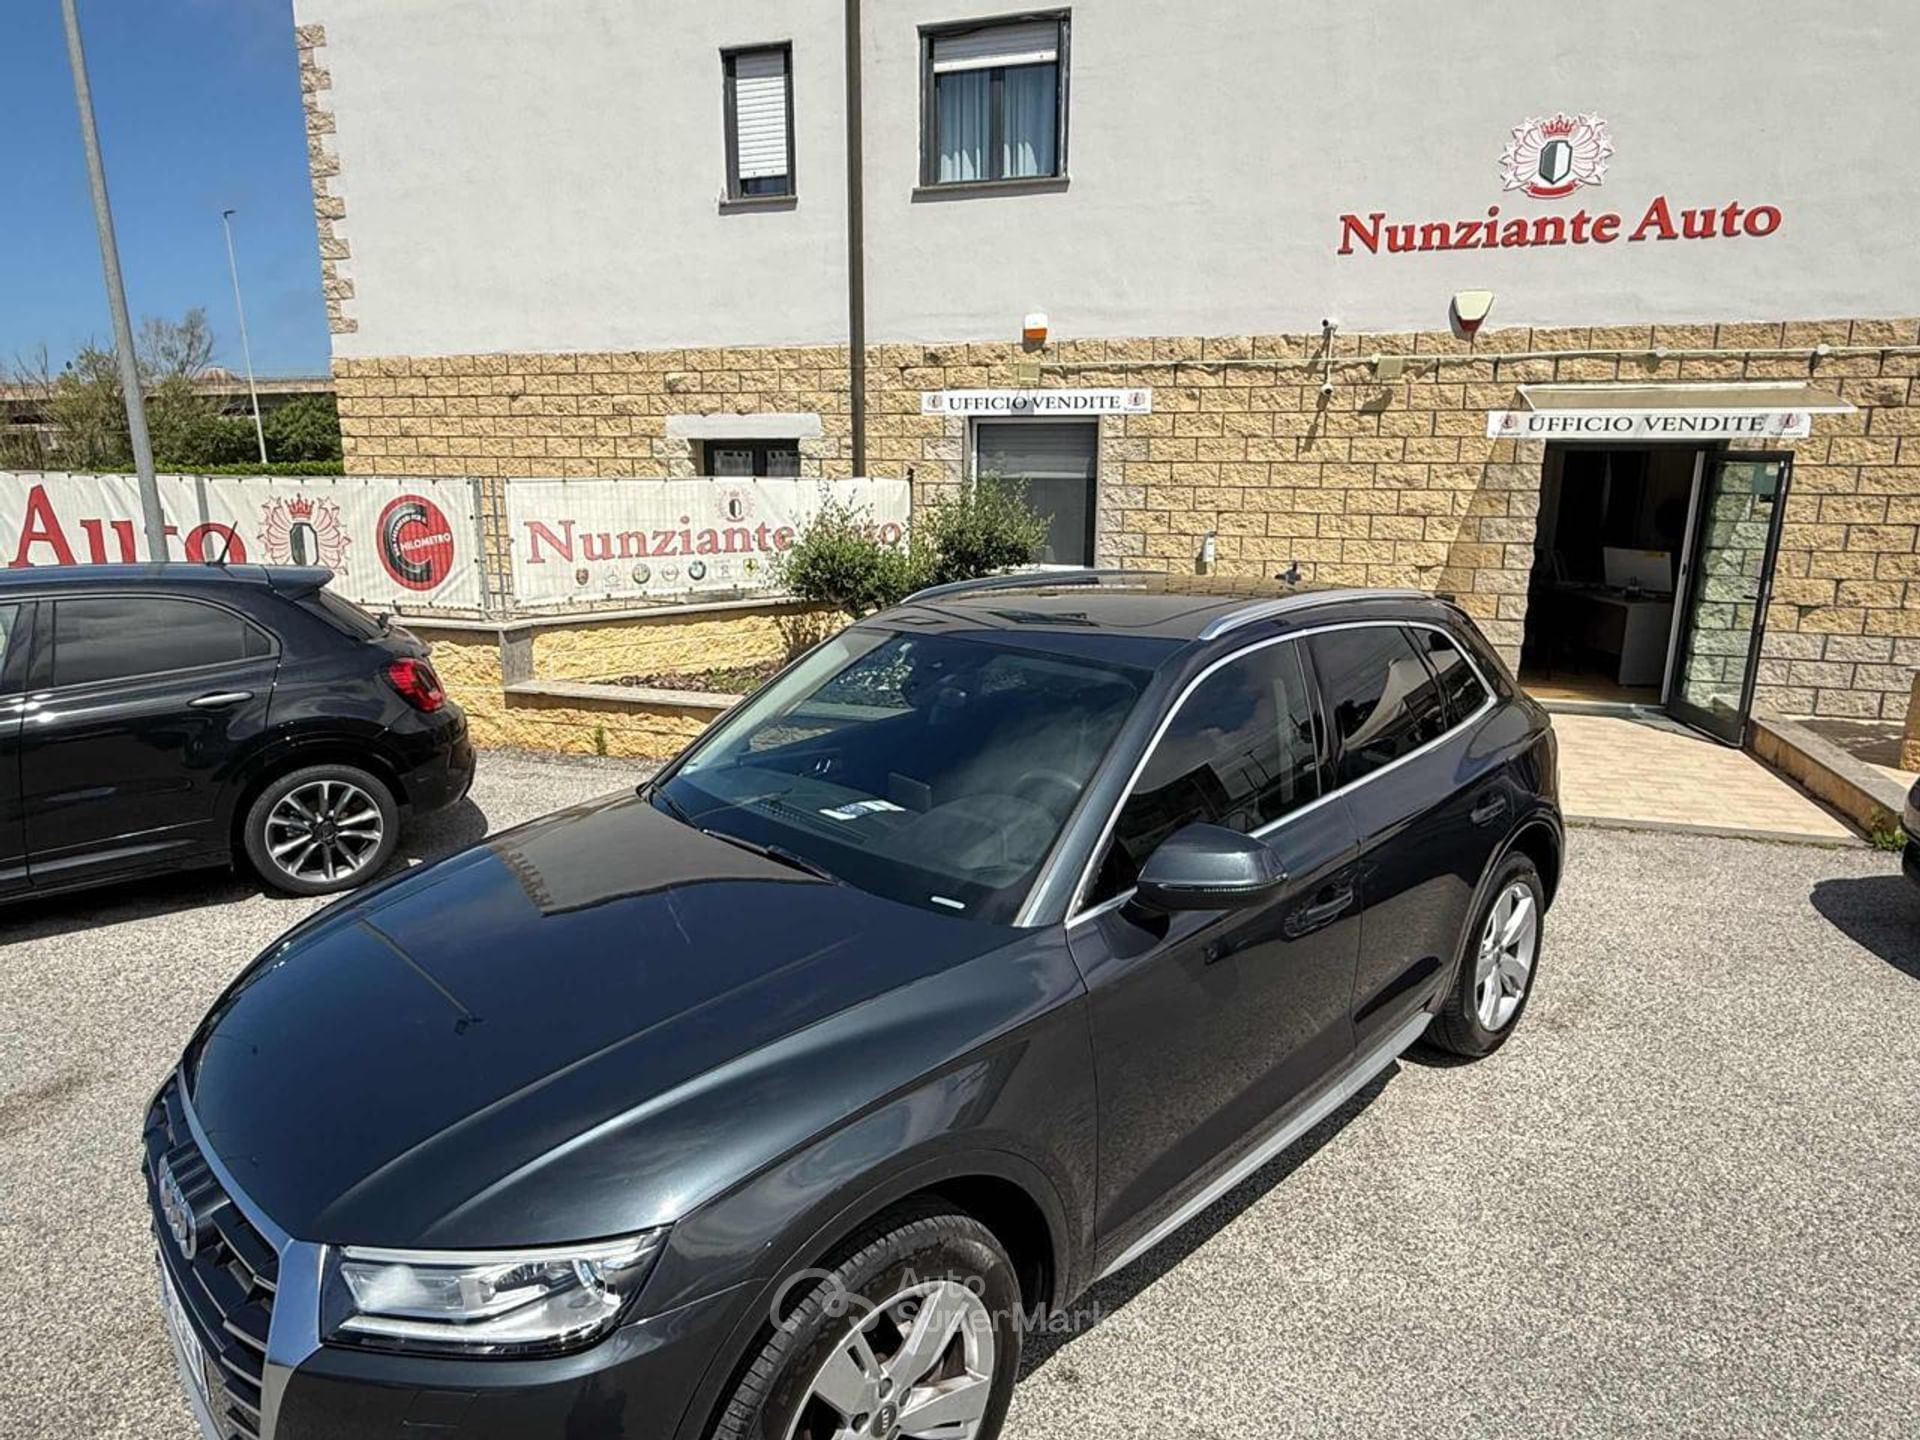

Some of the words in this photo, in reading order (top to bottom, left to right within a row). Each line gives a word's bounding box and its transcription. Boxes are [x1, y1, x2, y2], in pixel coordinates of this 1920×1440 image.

[1338, 206, 1620, 255] Nunziante
[1628, 195, 1782, 241] Auto
[948, 396, 1028, 411] UFFICIO
[1031, 395, 1121, 410] VENDITE
[1527, 415, 1634, 432] UFFICIO
[1643, 415, 1766, 432] VENDITE
[7, 483, 248, 569] Auo
[523, 515, 796, 564] Nunziante
